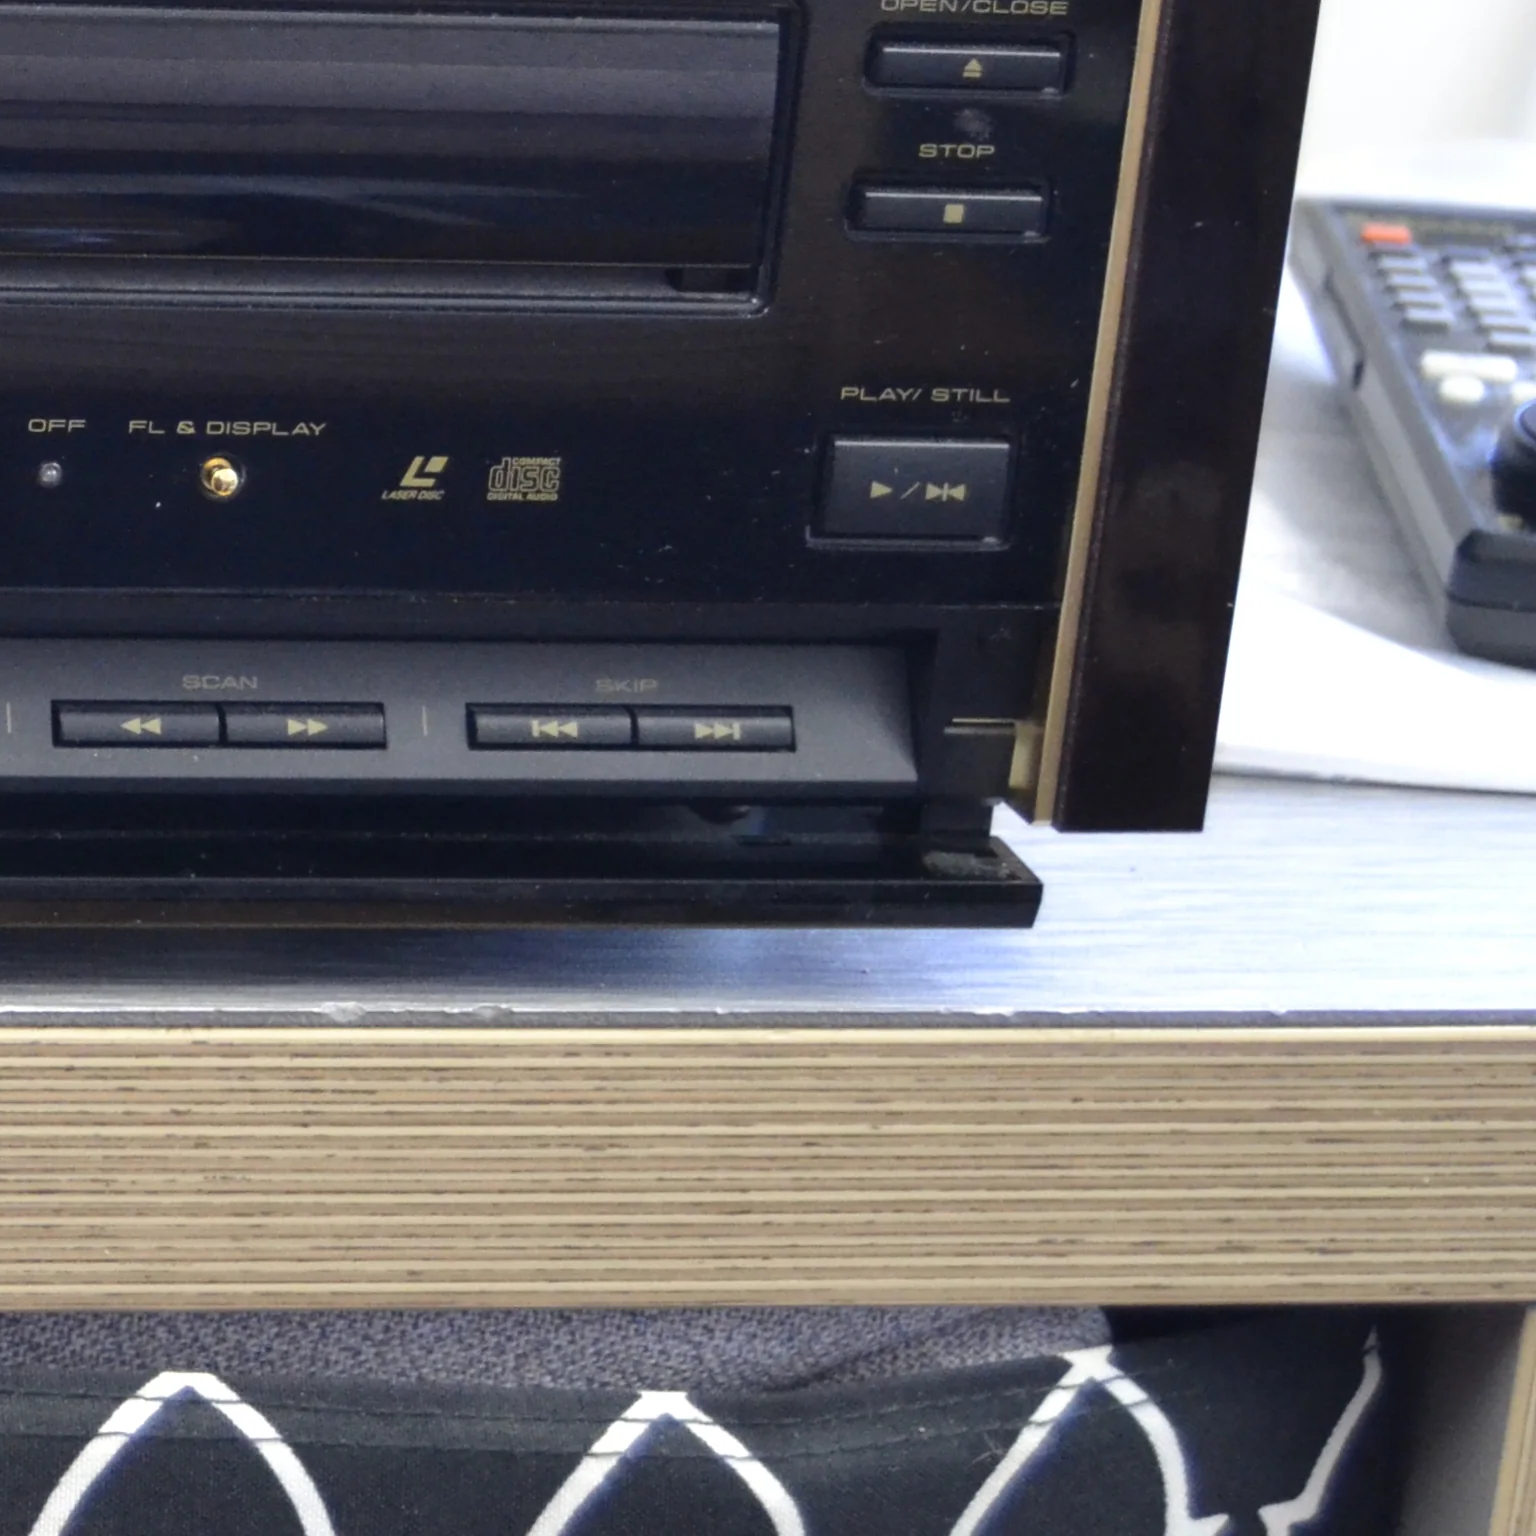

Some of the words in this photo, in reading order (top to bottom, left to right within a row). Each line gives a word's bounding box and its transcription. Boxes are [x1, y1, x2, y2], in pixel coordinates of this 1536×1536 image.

[918, 143, 996, 159] STOP
[930, 388, 1012, 403] STILL
[28, 419, 86, 433] OFF
[128, 420, 166, 434] FL
[176, 421, 197, 435] &
[206, 421, 326, 435] DISPLAY
[512, 456, 562, 466] COMPACT
[380, 489, 416, 501] LASER
[417, 489, 446, 501] DISC
[486, 491, 524, 501] DIGITAL
[526, 491, 559, 501] AUDIO
[181, 674, 258, 691] SCAN
[593, 677, 659, 694] SKIP
